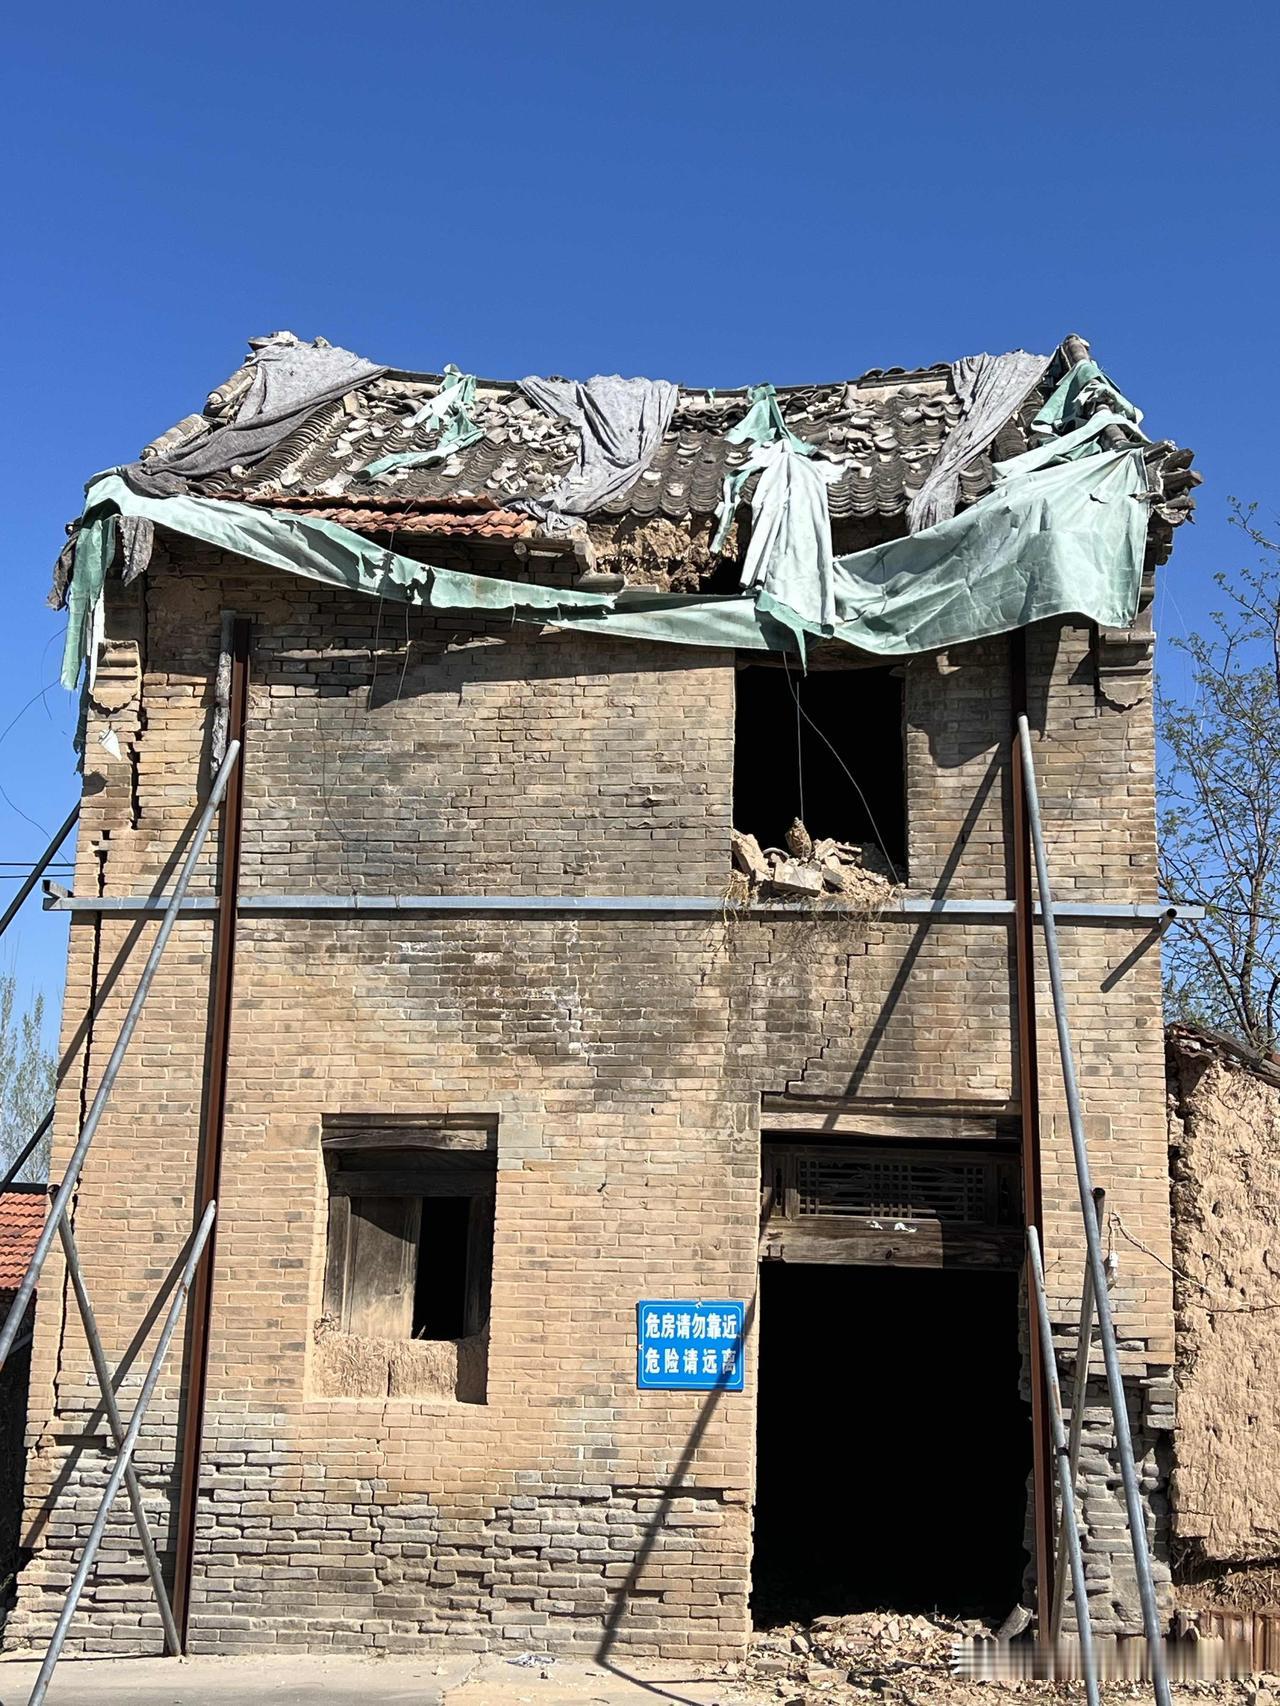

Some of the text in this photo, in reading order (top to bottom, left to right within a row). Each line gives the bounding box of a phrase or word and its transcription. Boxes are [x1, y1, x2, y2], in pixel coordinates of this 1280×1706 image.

[645, 1312, 737, 1339] 危房请勿靠近
[645, 1347, 736, 1375] 危险请远离
